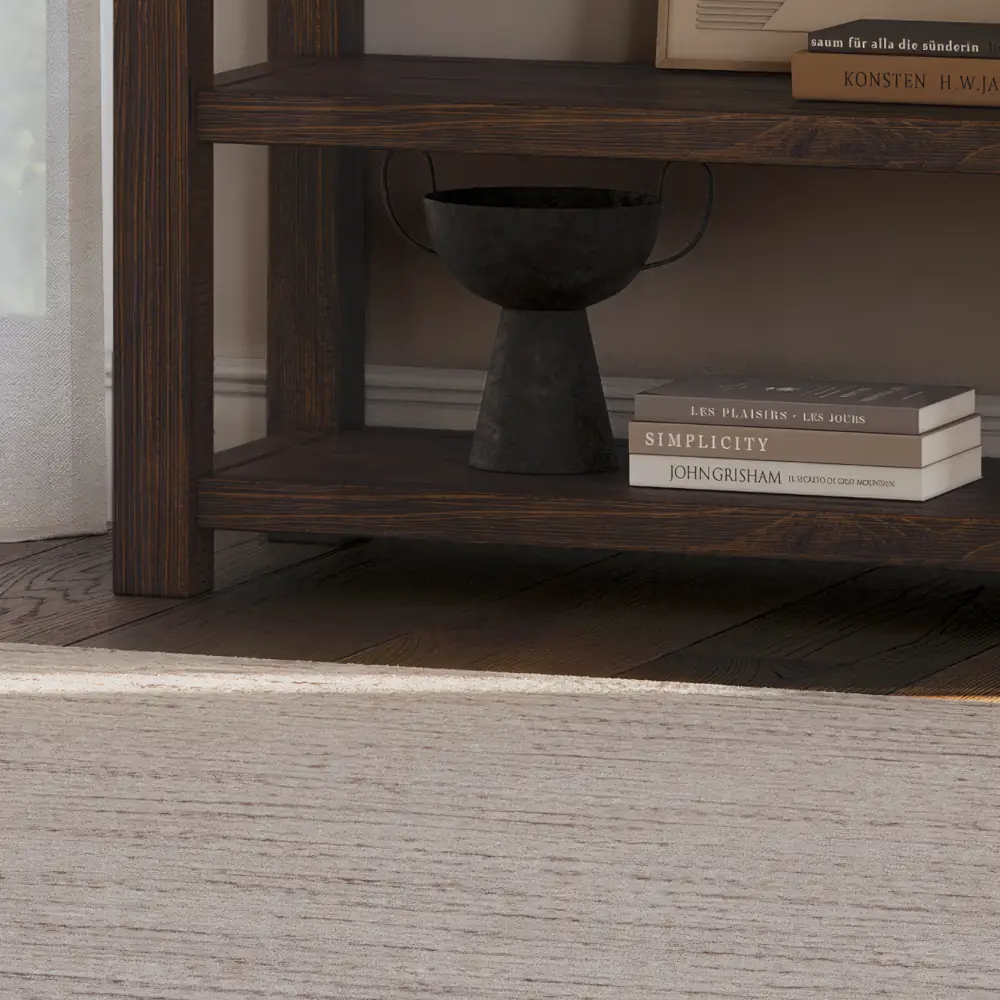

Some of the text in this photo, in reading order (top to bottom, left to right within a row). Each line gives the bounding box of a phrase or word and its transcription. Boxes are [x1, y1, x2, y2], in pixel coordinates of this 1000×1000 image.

[810, 37, 844, 48] saum
[848, 36, 868, 50] für
[871, 37, 894, 50] alla
[898, 38, 918, 51] die
[844, 71, 926, 89] KONSTEN
[691, 405, 866, 425] LES PLAISIRS LES JOURS
[645, 431, 769, 452] SIMPLICITY
